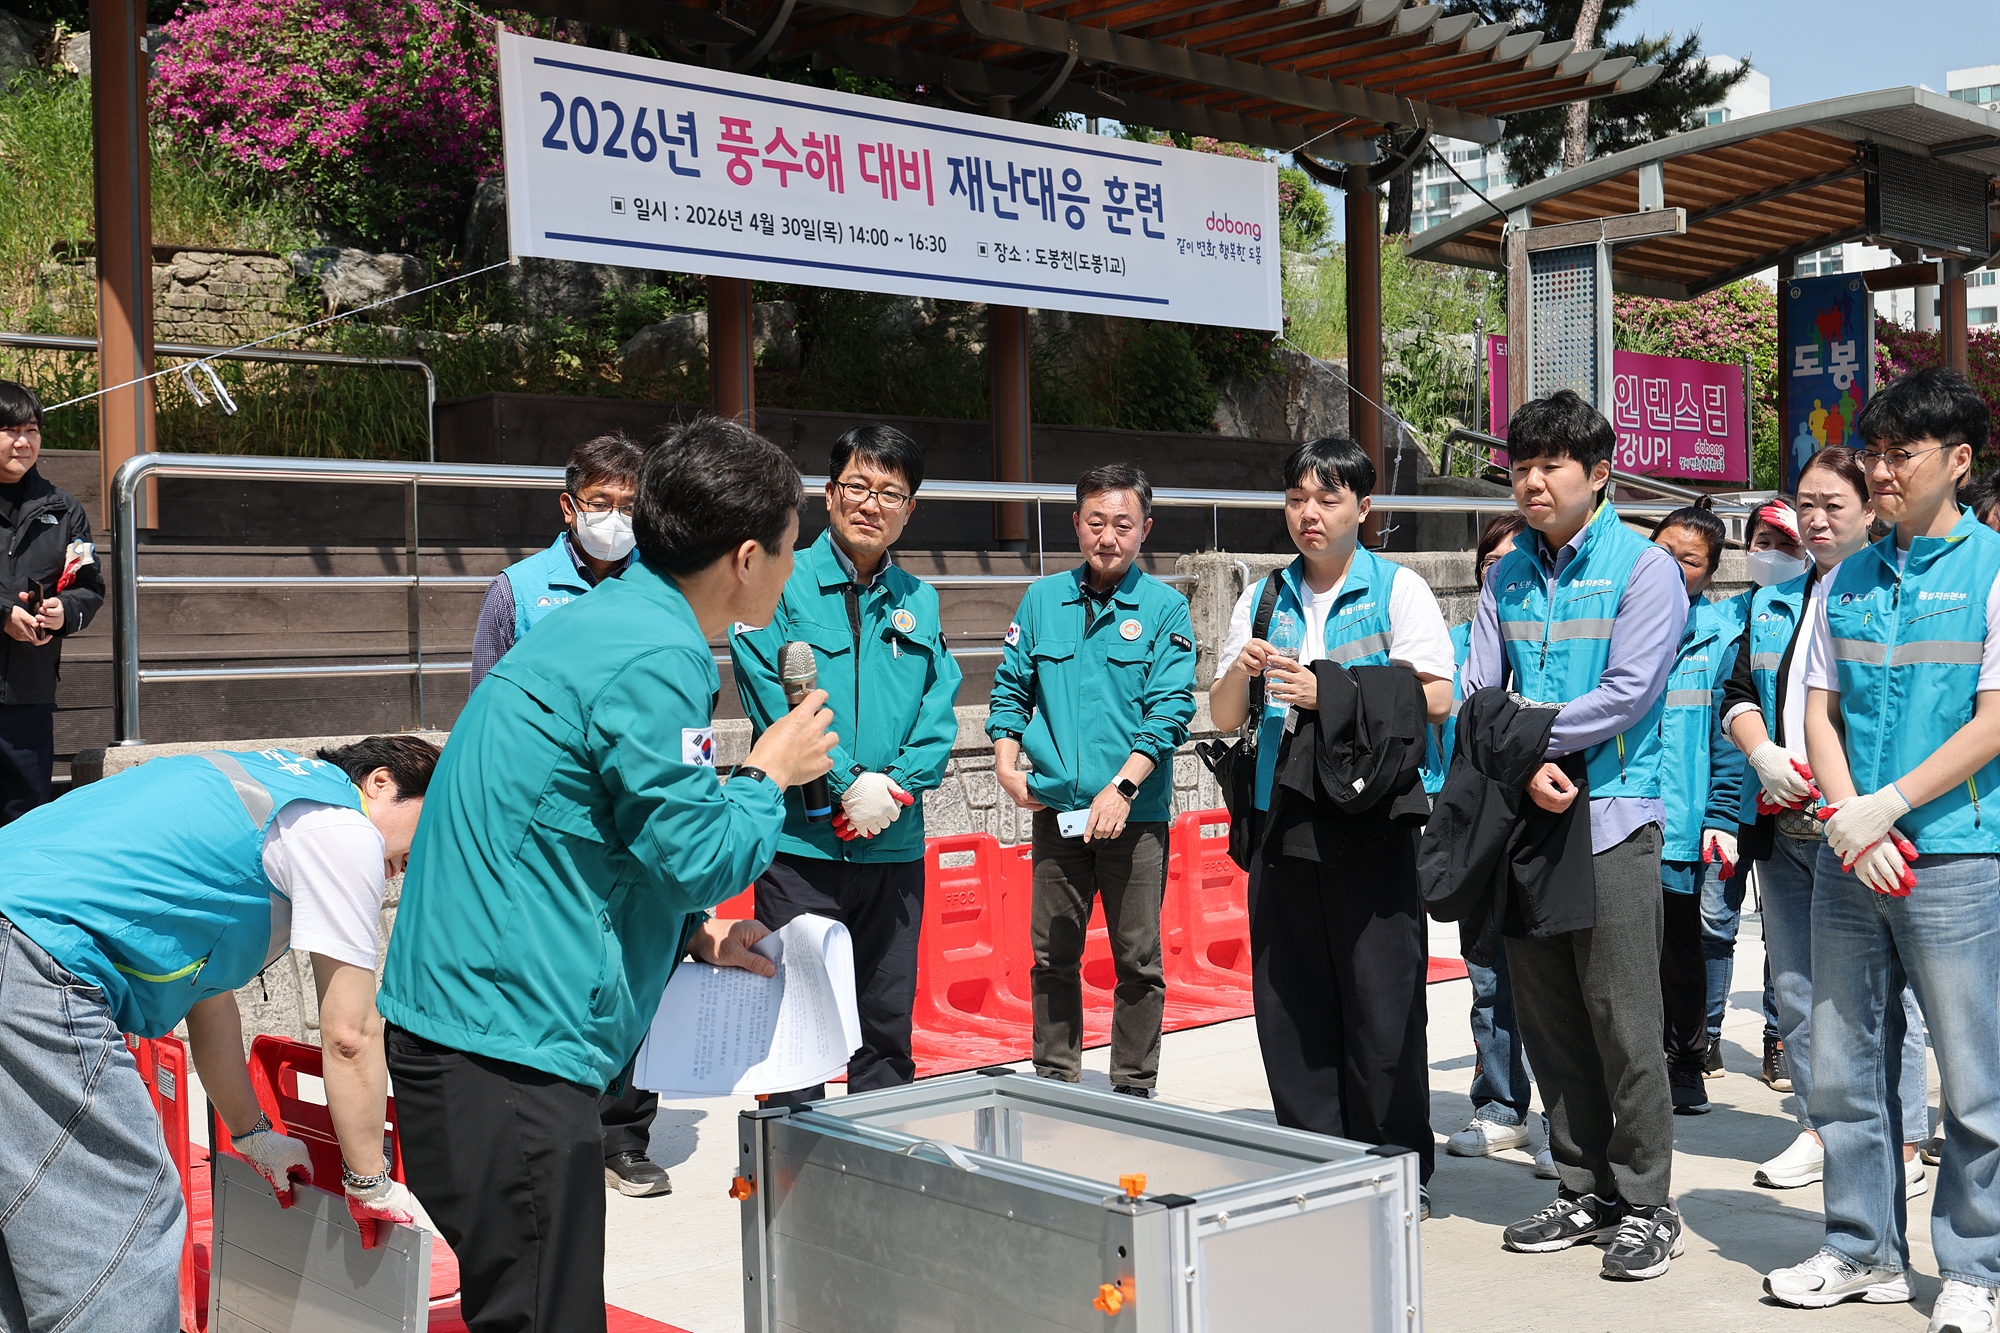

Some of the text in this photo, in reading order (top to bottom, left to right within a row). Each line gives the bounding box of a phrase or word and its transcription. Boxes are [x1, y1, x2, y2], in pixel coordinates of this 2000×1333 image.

[540, 91, 1165, 240] 2026년 풍수해 대비 재난대응 훈련
[633, 197, 667, 222] 일시
[686, 204, 743, 233] 2026년
[749, 212, 775, 236] 4월
[781, 217, 843, 245] 30일(목)
[848, 224, 889, 247] 14:00
[908, 232, 947, 254] 16:30
[1205, 210, 1262, 241] dobong
[993, 242, 1022, 264] 장소
[1034, 248, 1126, 277] 도봉천(도봉1교)
[1176, 237, 1262, 266] 같이 변화, 행복한 도봉
[1792, 341, 1859, 389] 도봉
[1694, 438, 1725, 458] dobong
[1571, 578, 1613, 588] 통합지원본부
[1918, 591, 1967, 601] 통합지원본부
[1339, 601, 1377, 616] 통합지원본부
